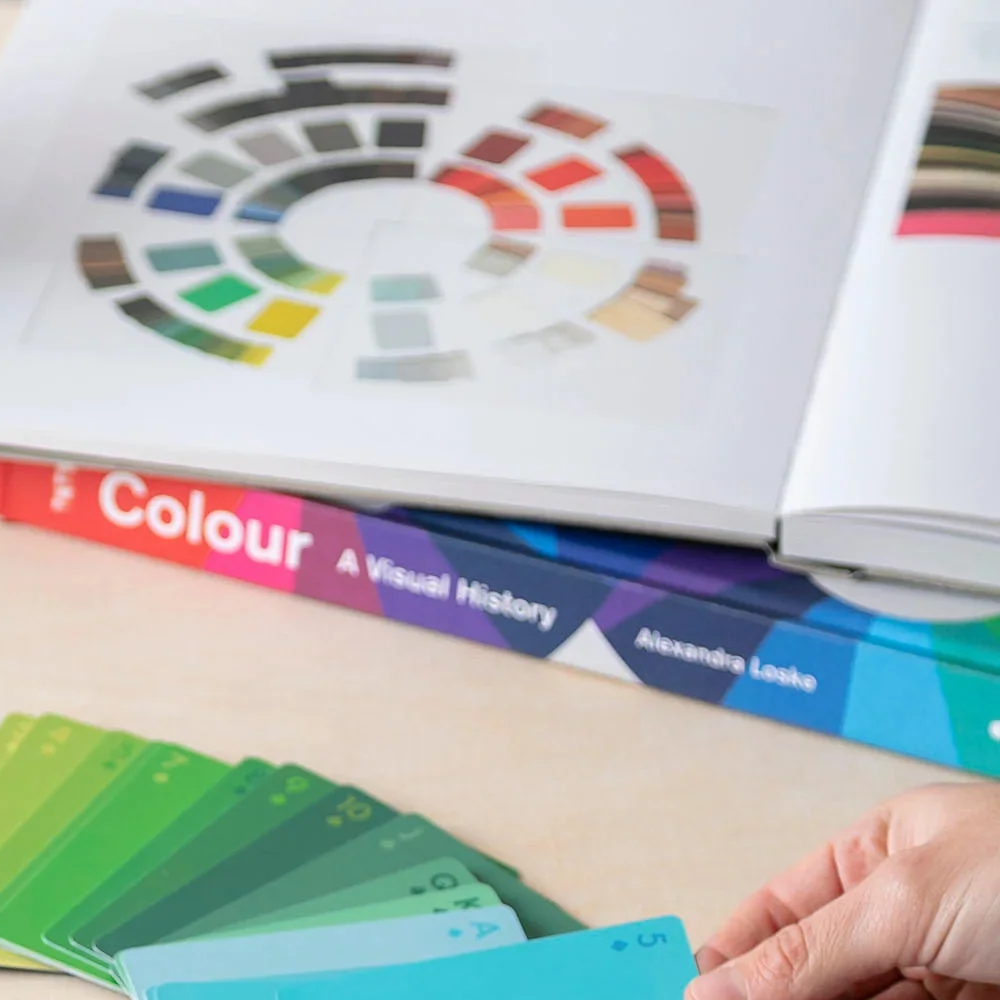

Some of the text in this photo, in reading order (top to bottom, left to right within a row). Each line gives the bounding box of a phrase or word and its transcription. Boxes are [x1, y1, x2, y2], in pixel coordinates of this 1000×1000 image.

[98, 470, 313, 569] Colour
[336, 549, 359, 576] A
[368, 554, 450, 598] Visual
[456, 577, 558, 631] History
[634, 627, 745, 675] Alexandra
[470, 921, 500, 940] A
[637, 932, 667, 948] 5
